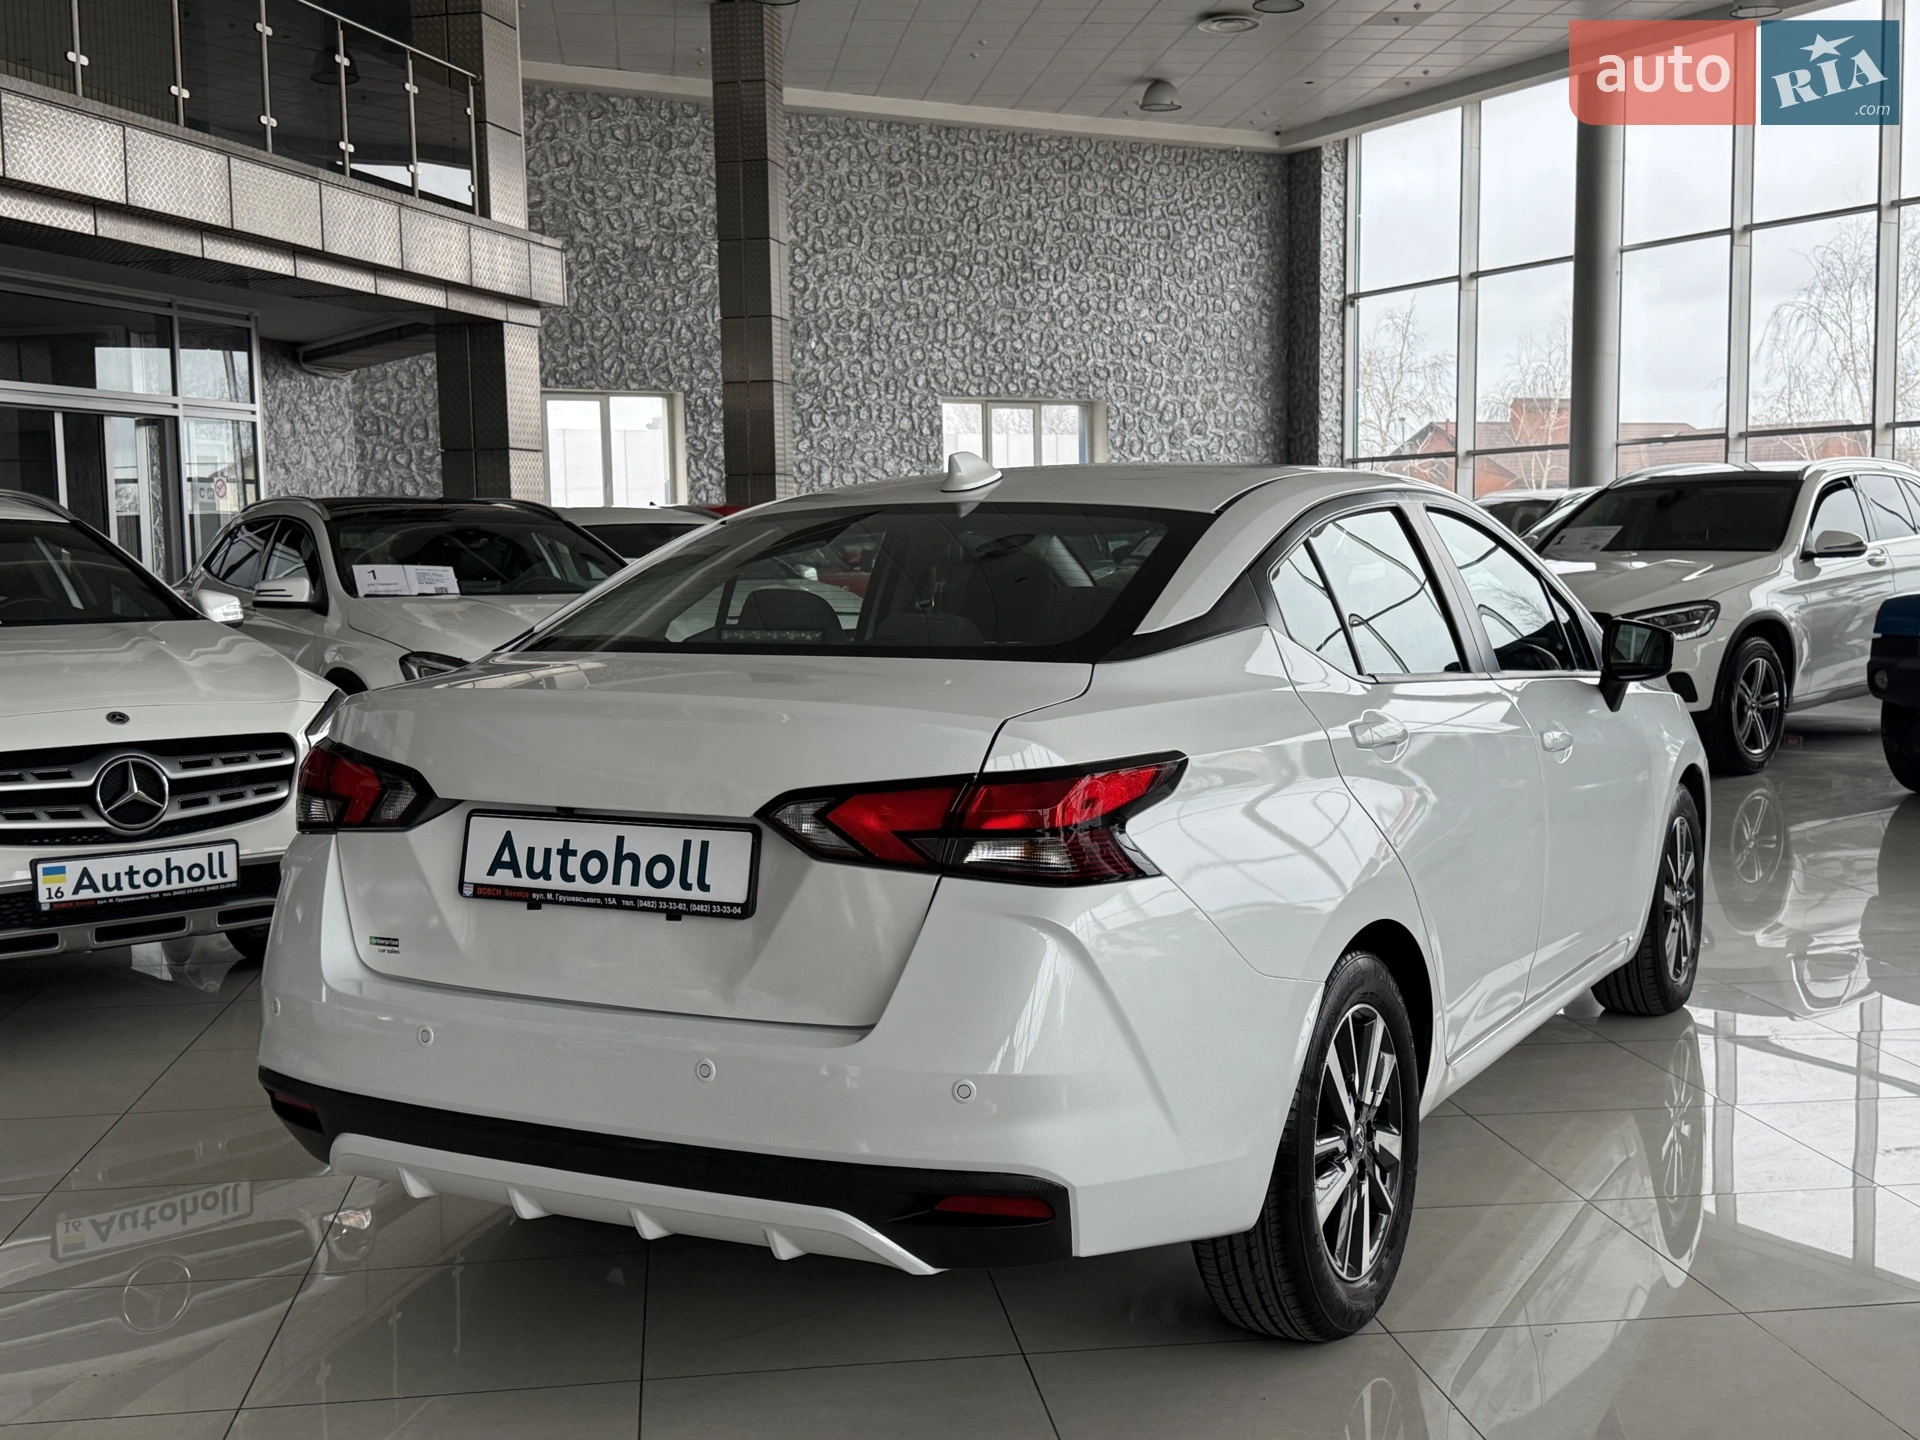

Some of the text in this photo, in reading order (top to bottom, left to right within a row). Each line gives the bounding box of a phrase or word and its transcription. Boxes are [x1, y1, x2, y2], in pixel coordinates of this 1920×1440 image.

[367, 569, 377, 580] 1
[46, 851, 228, 900] 16 Autoholl
[486, 830, 711, 893] Autoholl
[477, 887, 502, 896] BOSCH
[637, 899, 658, 909] (0482)
[690, 903, 711, 913] (0482)
[712, 905, 742, 914] 33-33-04
